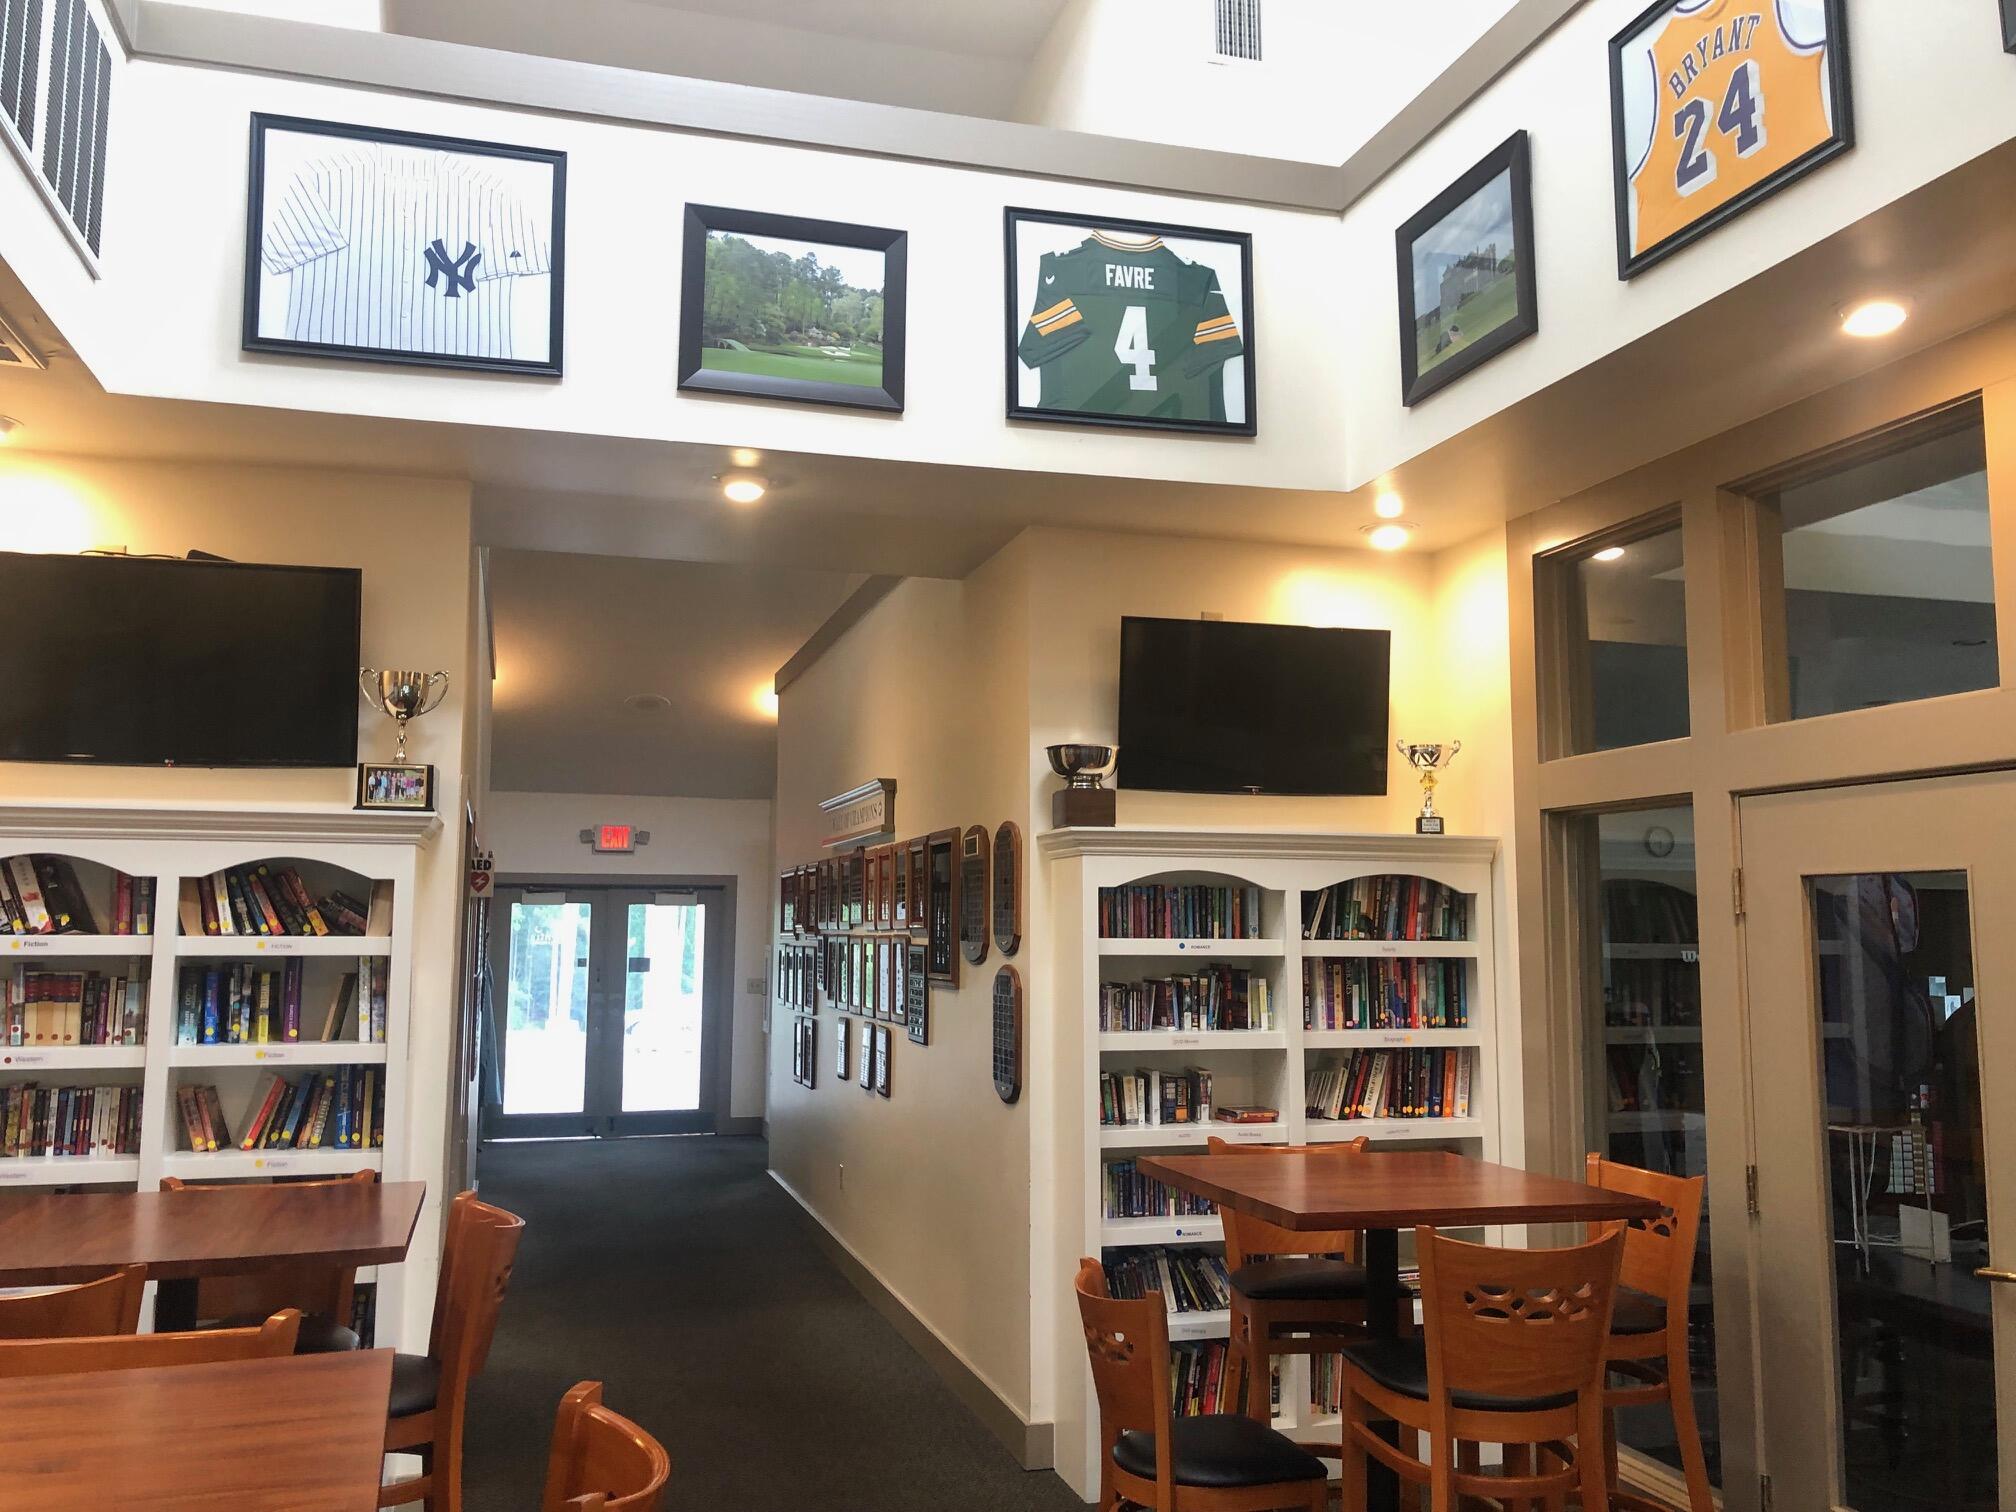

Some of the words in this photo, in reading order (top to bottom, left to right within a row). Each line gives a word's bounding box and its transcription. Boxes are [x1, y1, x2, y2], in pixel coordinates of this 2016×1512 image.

[1668, 14, 1761, 99] BRYANT
[1673, 58, 1767, 198] 24
[1105, 263, 1155, 290] FAVRE
[1114, 305, 1158, 391] 4
[471, 859, 492, 871] AED
